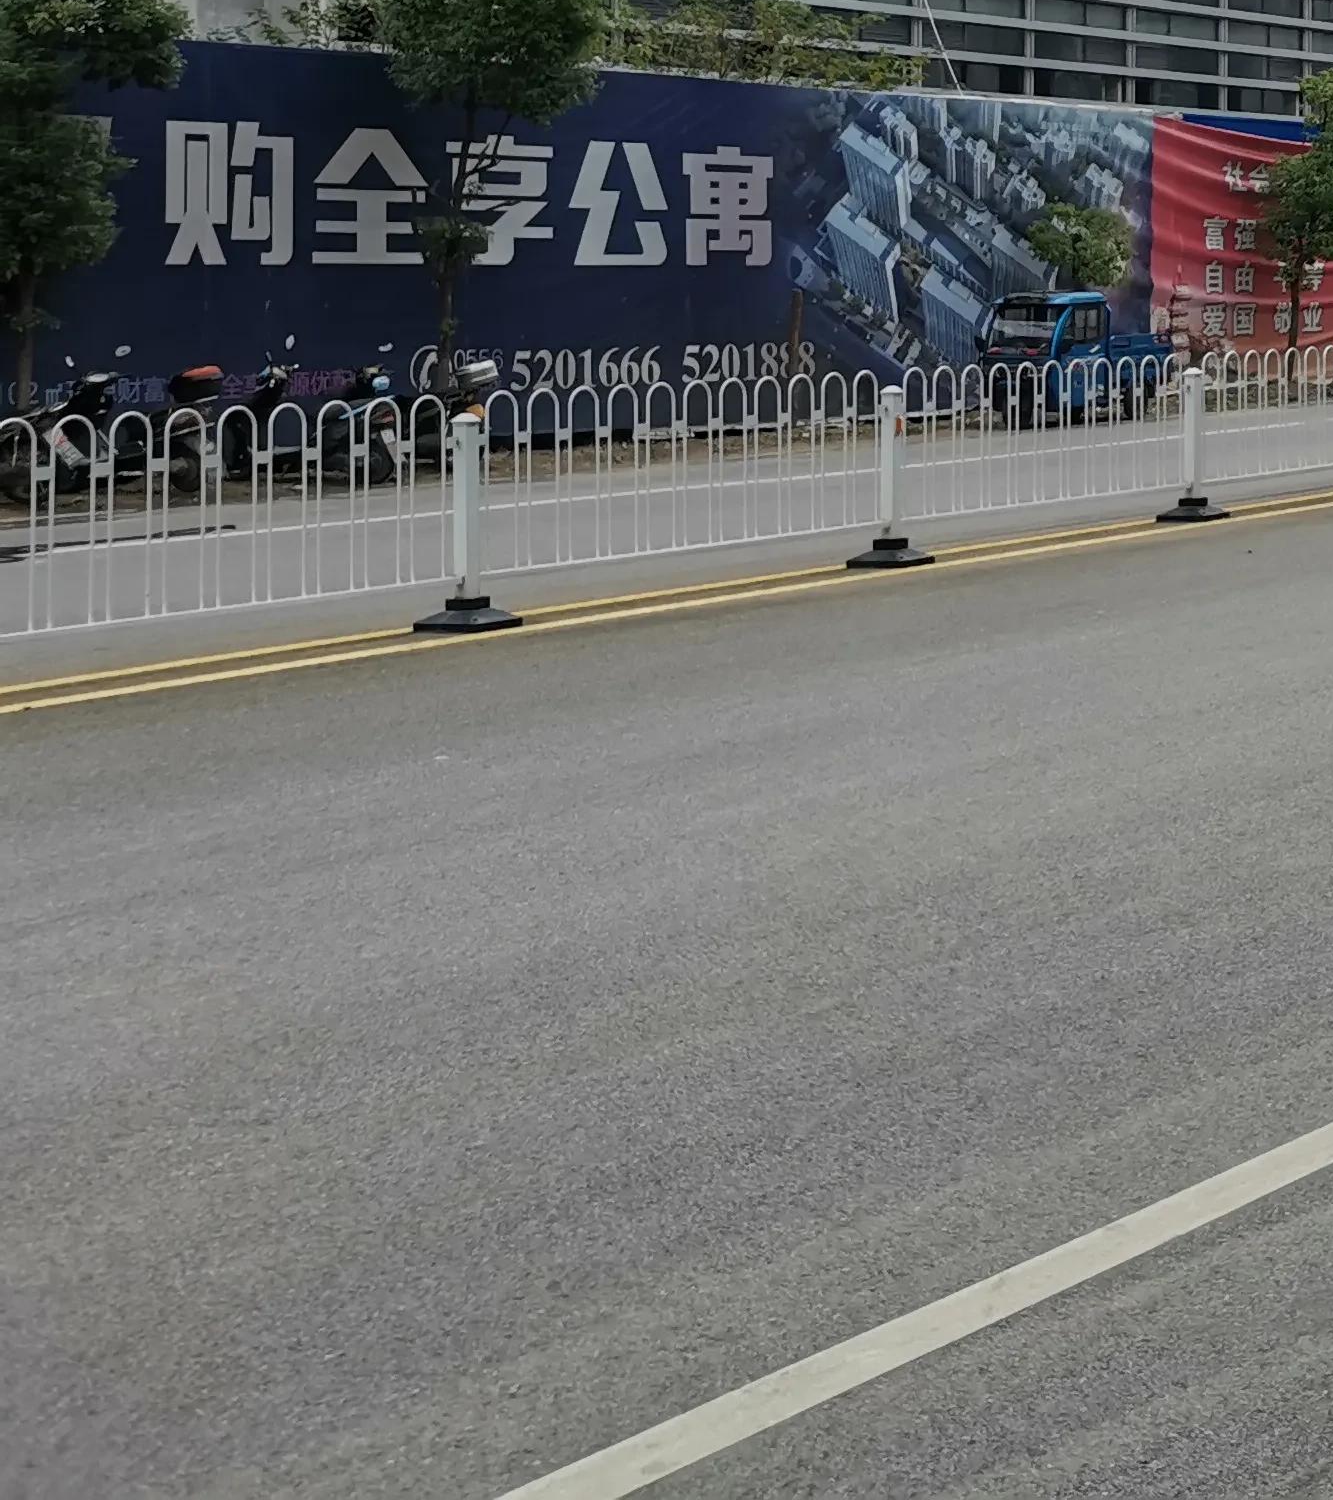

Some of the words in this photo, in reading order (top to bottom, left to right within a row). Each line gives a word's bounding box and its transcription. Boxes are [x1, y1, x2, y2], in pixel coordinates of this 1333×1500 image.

[1203, 218, 1257, 250] 富强
[1204, 260, 1255, 294] 自由
[1202, 303, 1257, 338] 爱国
[510, 345, 661, 391] 5201666
